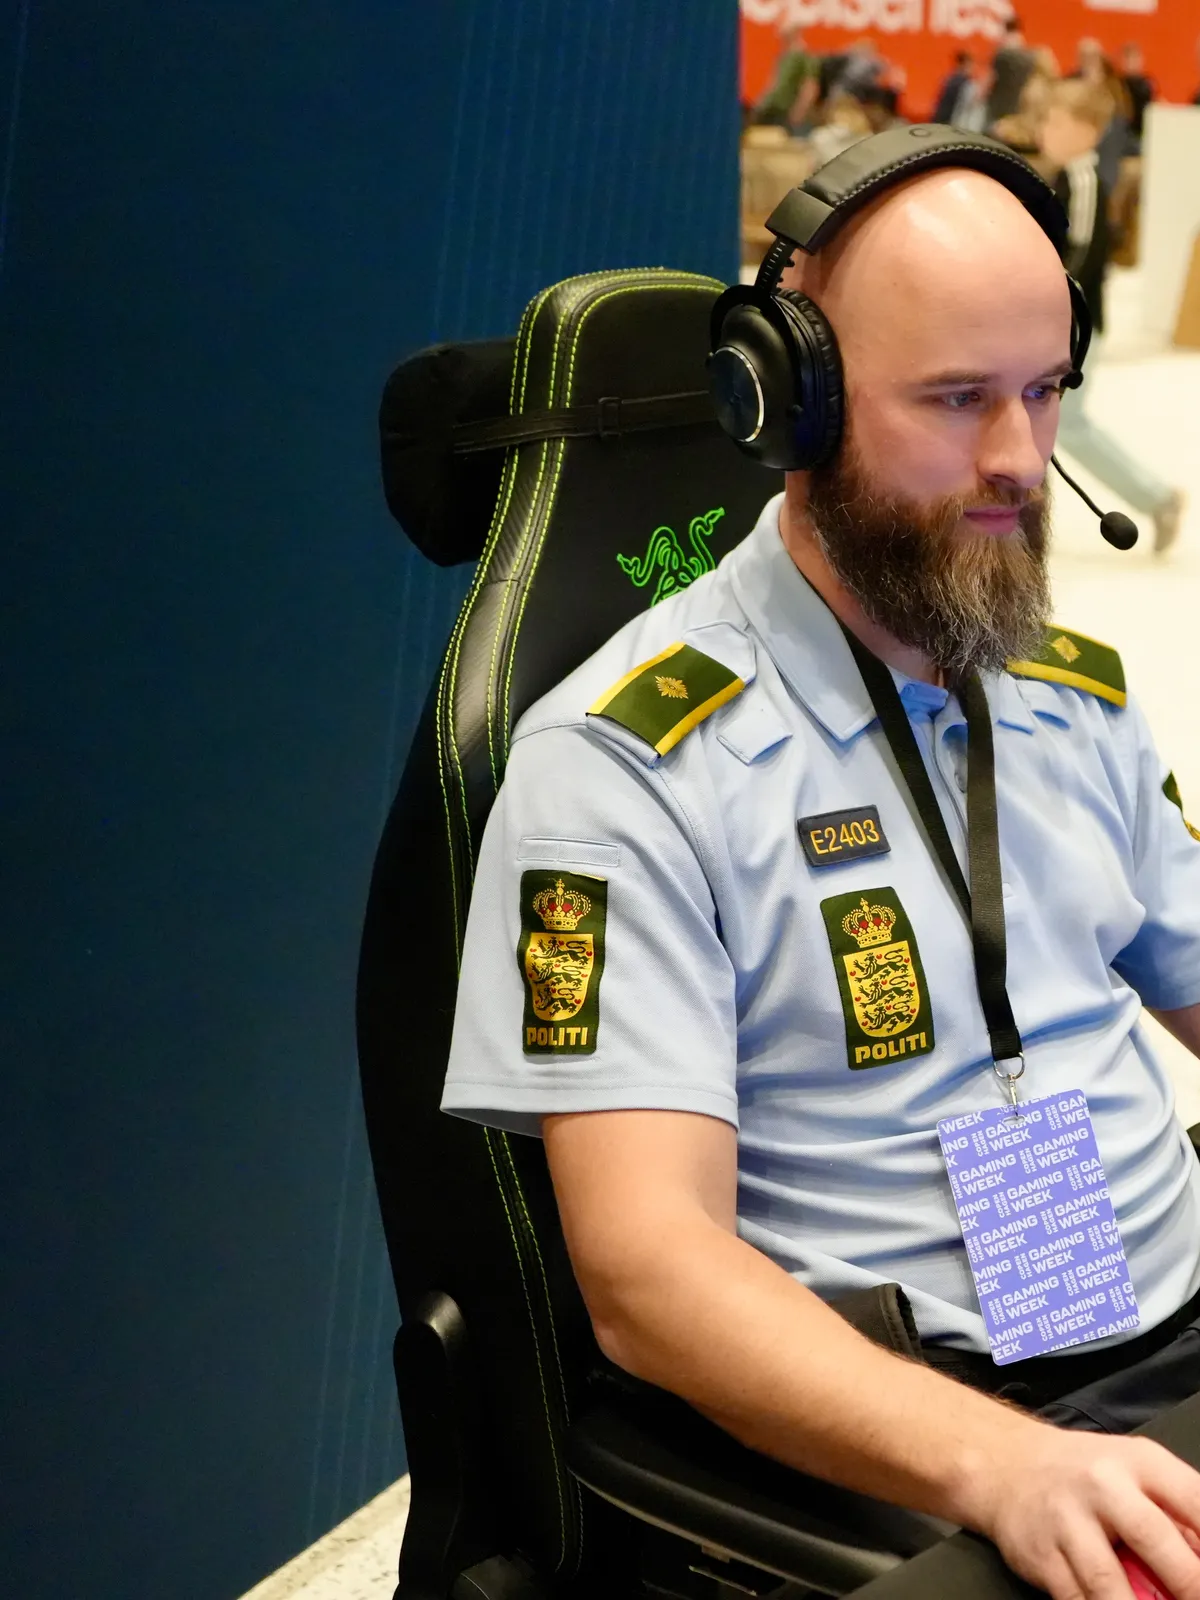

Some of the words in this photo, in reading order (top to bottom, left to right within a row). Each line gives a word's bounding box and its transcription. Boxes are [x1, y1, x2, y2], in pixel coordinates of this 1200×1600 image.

[810, 819, 881, 855] E2403
[526, 1027, 589, 1047] POLITI
[854, 1031, 928, 1064] POLITI
[941, 1112, 984, 1134] WEEK
[1044, 1107, 1056, 1130] COPEN
[1050, 1104, 1063, 1129] HAGEN
[971, 1133, 983, 1157] COPEN
[977, 1130, 990, 1155] HAGEN
[989, 1128, 1032, 1152] WEEK
[1032, 1128, 1089, 1156] GAMING
[958, 1154, 1017, 1183] GAMING
[1019, 1150, 1031, 1174] COPEN
[1025, 1148, 1037, 1172] HAGEN
[1036, 1145, 1079, 1168] WEEK
[962, 1172, 1006, 1196] WEEK
[1006, 1170, 1064, 1200] GAMING
[1066, 1166, 1078, 1191] COPEN
[1072, 1164, 1084, 1189] HAGEN
[992, 1194, 1005, 1218] COPEN
[998, 1191, 1011, 1216] HAGEN
[1010, 1189, 1054, 1213] WEEK
[1054, 1188, 1110, 1216] GAMING
[980, 1214, 1039, 1244] GAMING
[1040, 1211, 1052, 1235] COPEN
[1046, 1208, 1059, 1233] HAGEN
[1058, 1206, 1100, 1229] WEEK
[972, 1236, 985, 1261] HAGEN
[984, 1233, 1028, 1258] WEEK
[1028, 1232, 1085, 1261] GAMING
[1087, 1227, 1099, 1251] COPEN
[1093, 1225, 1106, 1249] HAGEN
[966, 1239, 979, 1263] COPEN
[1032, 1250, 1075, 1274] WEEK
[1014, 1256, 1027, 1280] COPEN
[1020, 1252, 1033, 1278] HAGEN
[1061, 1272, 1074, 1296] COPEN
[1067, 1269, 1080, 1294] HAGEN
[1079, 1266, 1122, 1290] WEEK
[1002, 1276, 1060, 1306] GAMING
[1108, 1289, 1121, 1312] COPEN
[1114, 1286, 1127, 1310] HAGEN
[988, 1301, 1000, 1325] COPEN
[994, 1298, 1007, 1323] HAGEN
[1006, 1295, 1049, 1320] WEEK
[1050, 1292, 1107, 1323] GAMING
[1036, 1317, 1048, 1341] COPEN
[1042, 1314, 1054, 1340] HAGEN
[1054, 1311, 1096, 1336] WEEK
